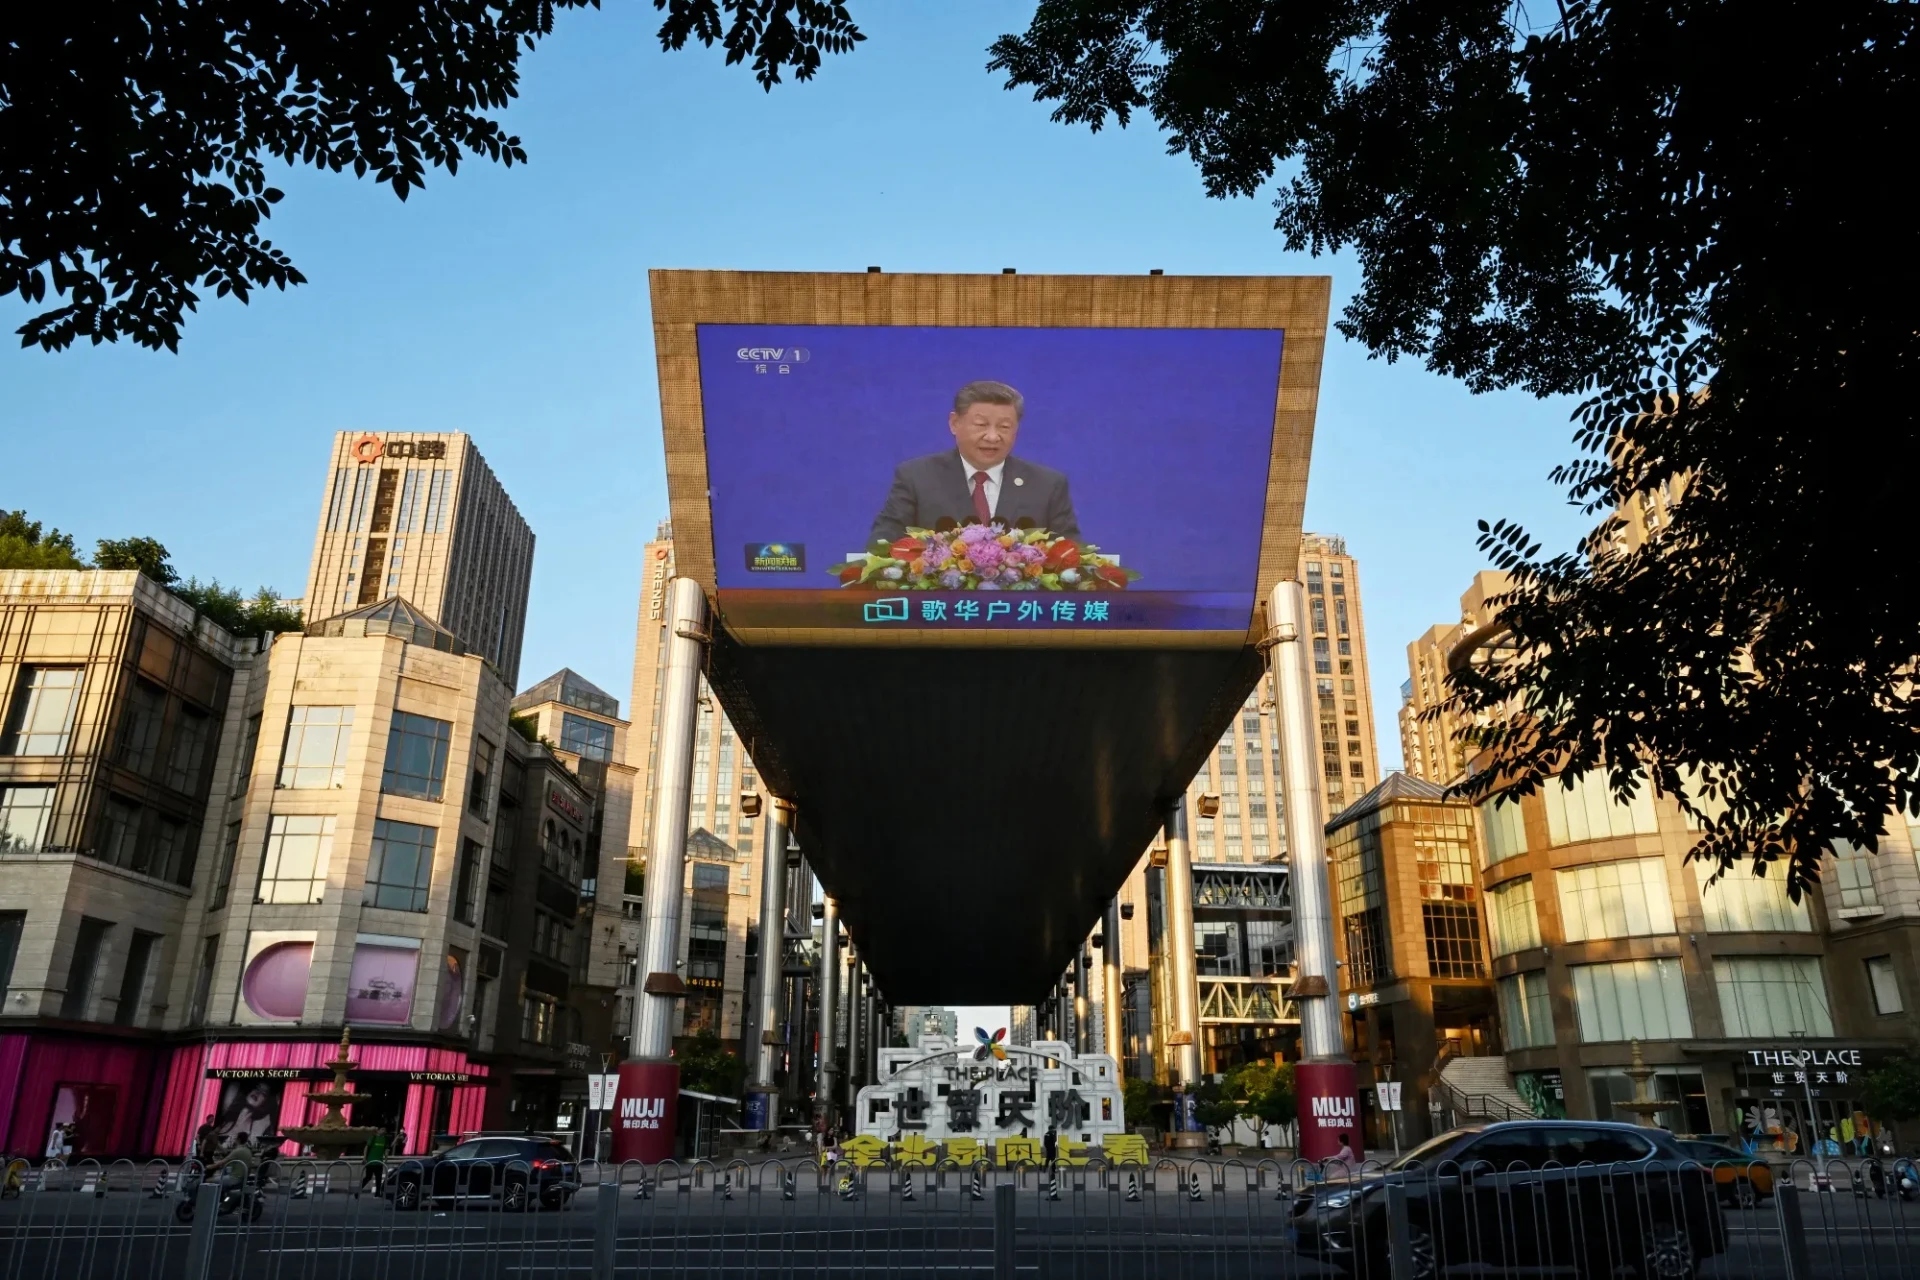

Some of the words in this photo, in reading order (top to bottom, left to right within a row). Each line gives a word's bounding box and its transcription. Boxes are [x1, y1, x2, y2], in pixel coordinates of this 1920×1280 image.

[737, 348, 784, 360] CCTV
[794, 350, 801, 361] 1
[755, 364, 790, 374] 综合
[650, 560, 665, 621] TRENDS
[921, 600, 1110, 622] 歌华户外传媒
[1748, 1050, 1795, 1066] THE
[1801, 1050, 1862, 1065] PLACE
[216, 1069, 265, 1078] VICTORIA'S
[267, 1069, 300, 1078] SECRET
[410, 1072, 456, 1081] VICTORIA'S
[945, 1067, 979, 1081] THE
[985, 1066, 1038, 1081] PLACE
[1772, 1071, 1848, 1084] 世贸天阶
[620, 1098, 665, 1118] MUJI
[892, 1088, 1090, 1130] 世贸天阶
[1311, 1097, 1355, 1117] MUJI
[622, 1119, 659, 1129] 無印良品
[1317, 1118, 1353, 1128] 無印良品
[843, 1134, 1149, 1166] 全北京向上看
